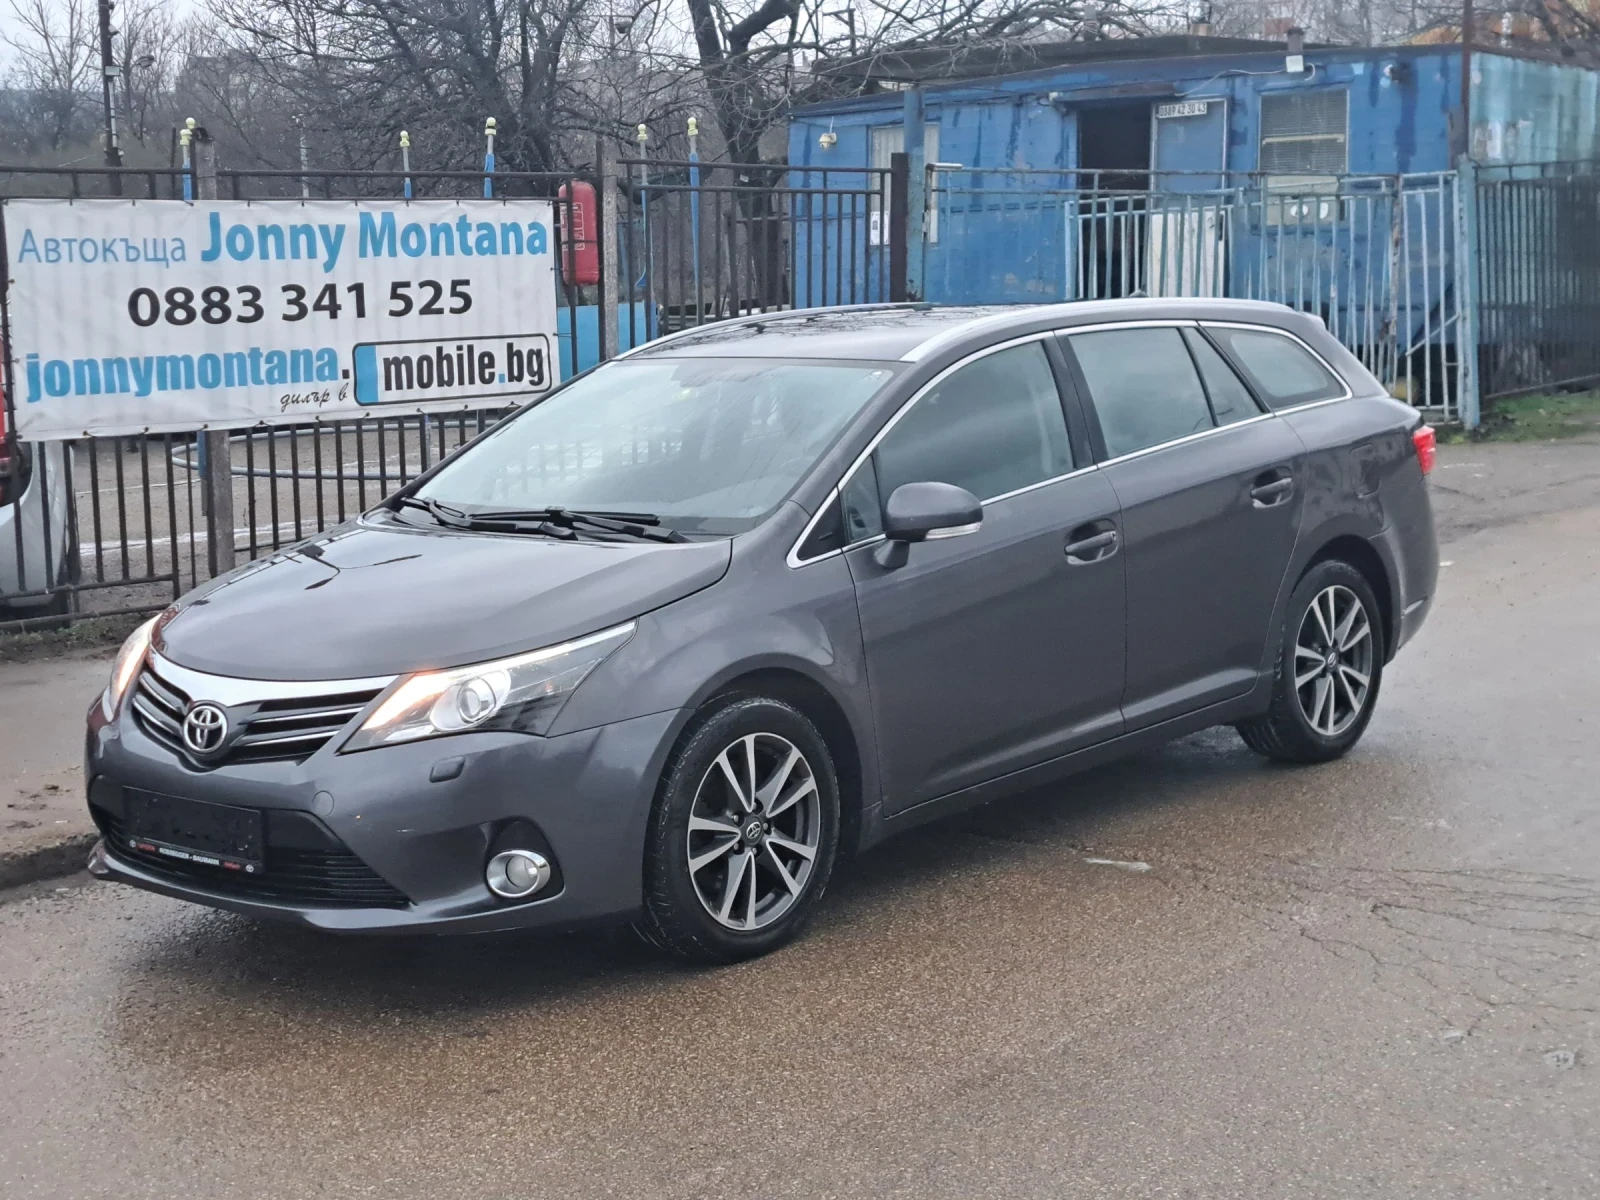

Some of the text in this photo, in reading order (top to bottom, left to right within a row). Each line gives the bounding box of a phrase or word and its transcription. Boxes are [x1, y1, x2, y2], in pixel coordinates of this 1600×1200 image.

[18, 229, 187, 269] Автокъща
[201, 211, 346, 272] Jonny
[359, 211, 548, 258] Montana
[129, 280, 472, 326] 0883 341 525
[383, 342, 545, 391] mobile.bg
[280, 382, 349, 413] дилър в
